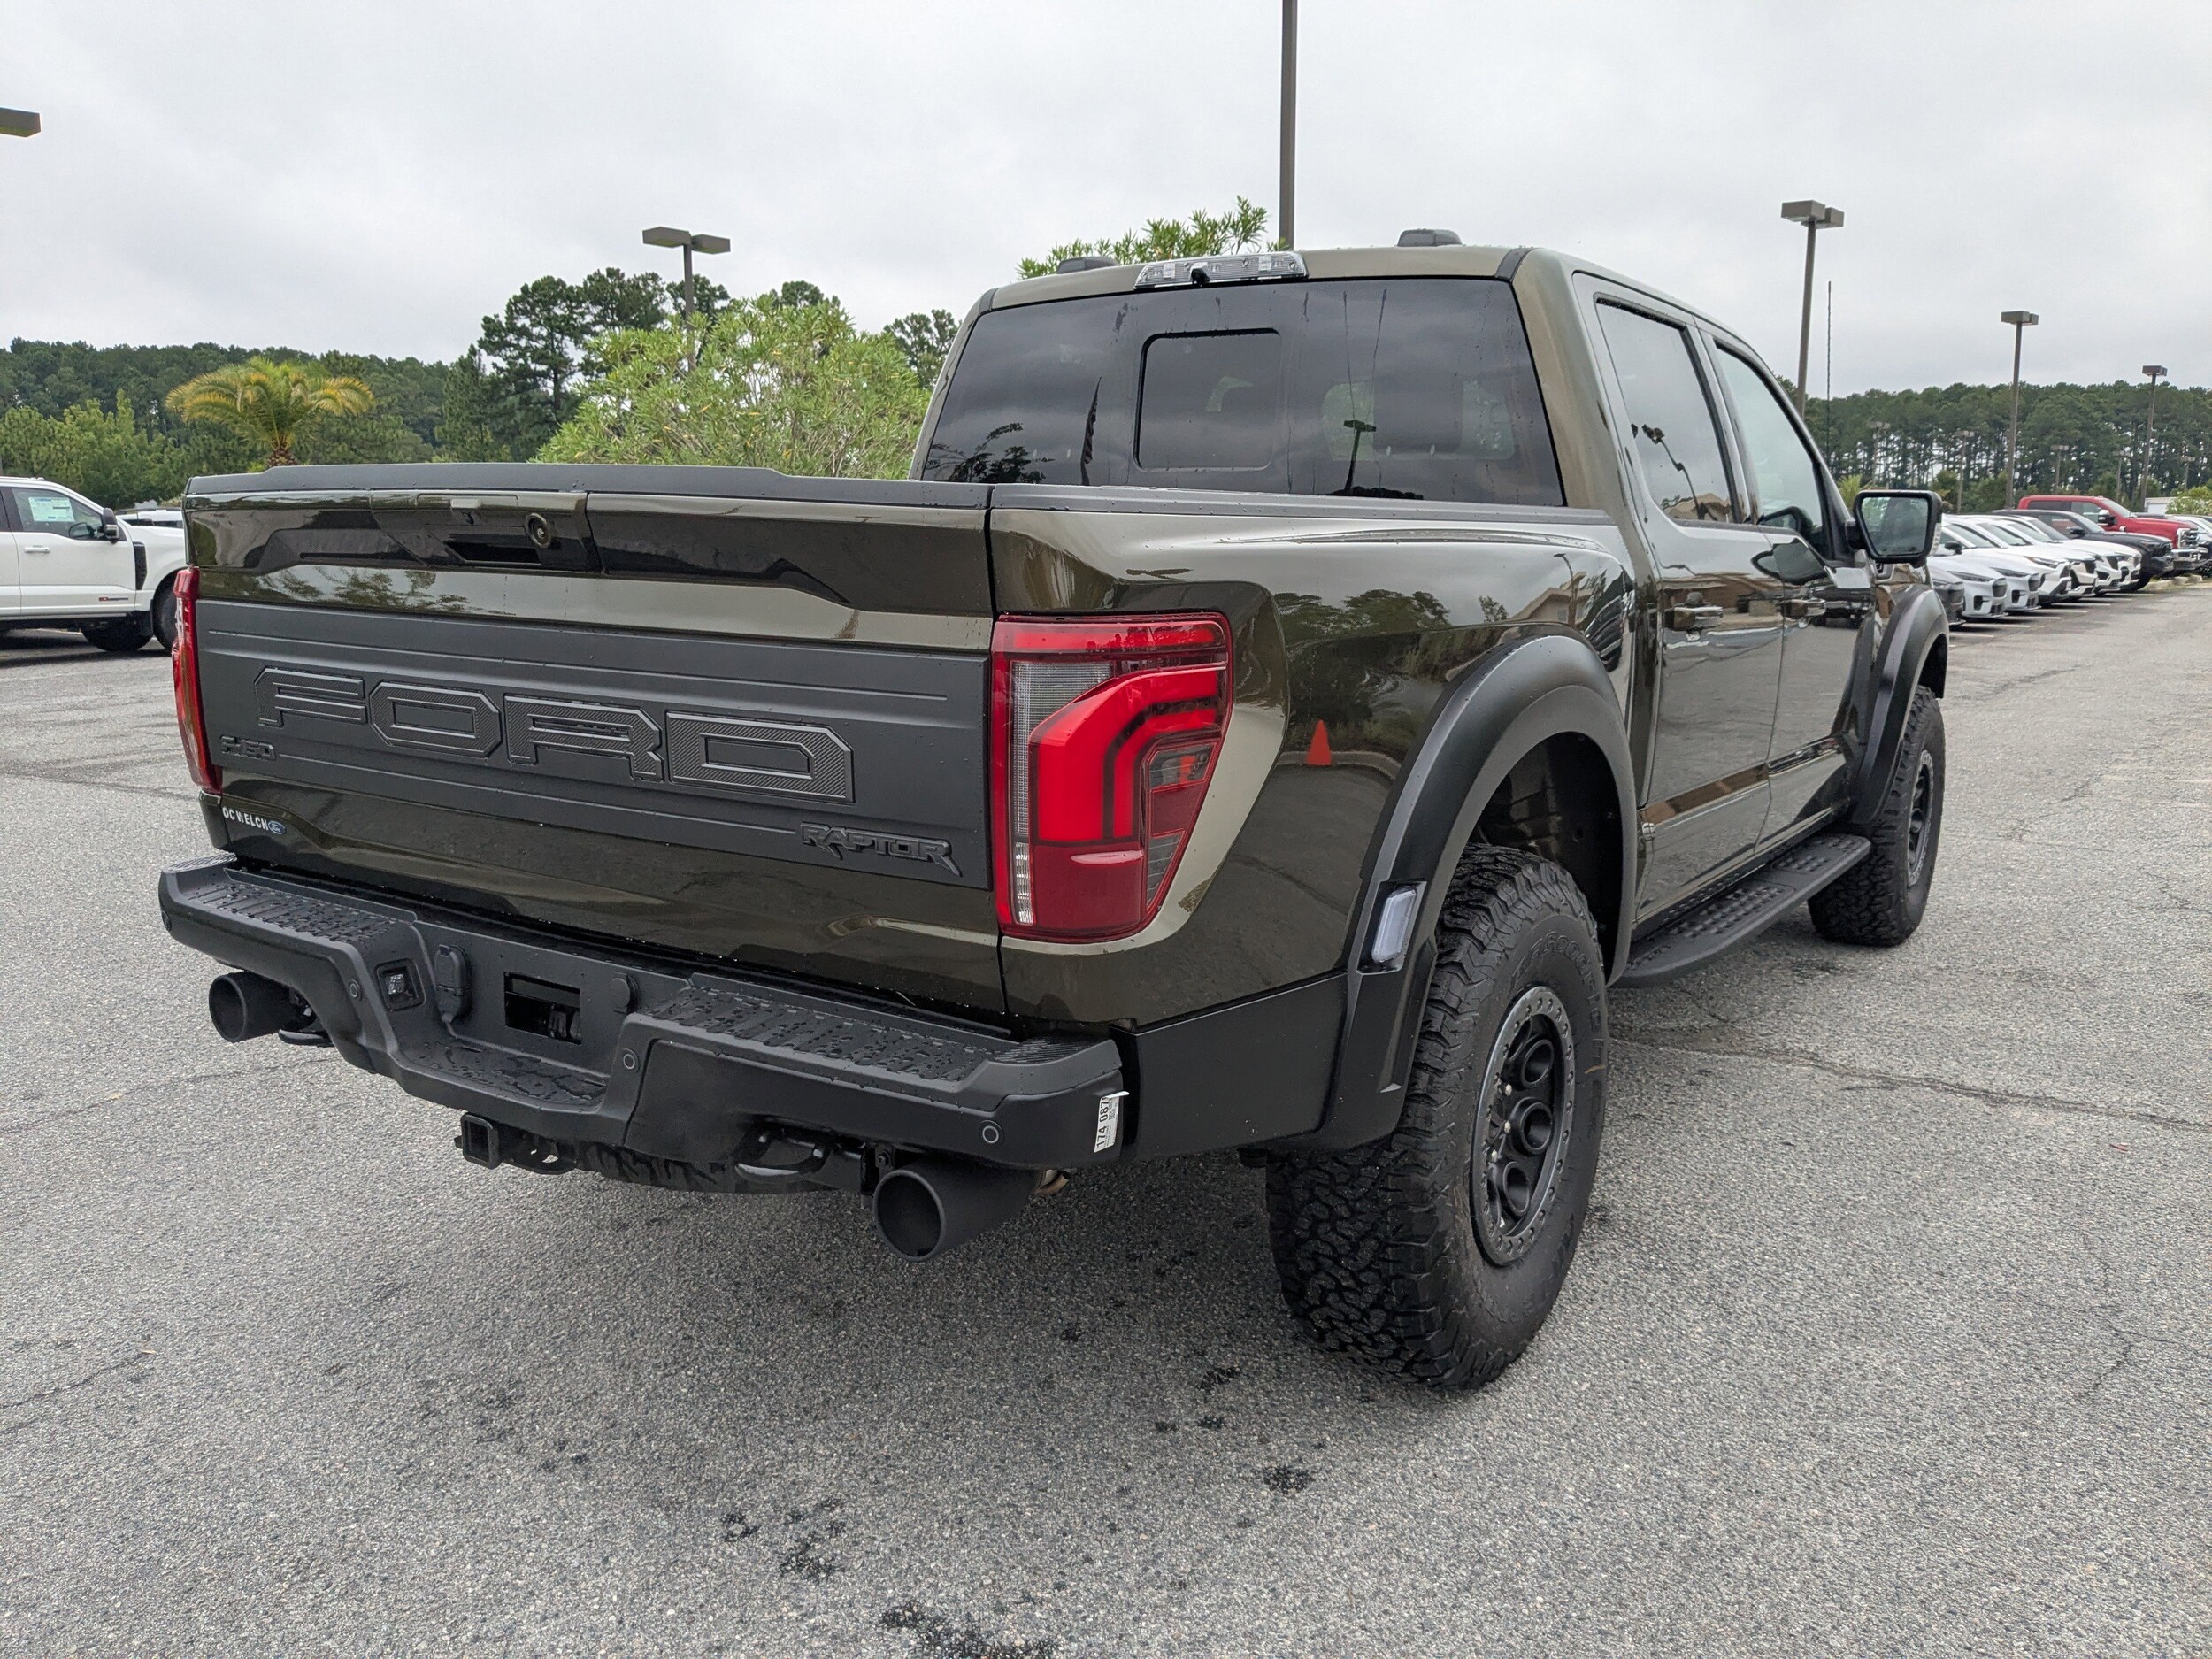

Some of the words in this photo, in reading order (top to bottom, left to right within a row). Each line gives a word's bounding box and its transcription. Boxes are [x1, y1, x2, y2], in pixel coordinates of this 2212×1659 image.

[254, 667, 856, 803] FORD
[222, 806, 235, 821] OC
[235, 809, 269, 831] WELCH
[801, 821, 963, 877] RAPTOR
[1096, 1125, 1107, 1148] 174
